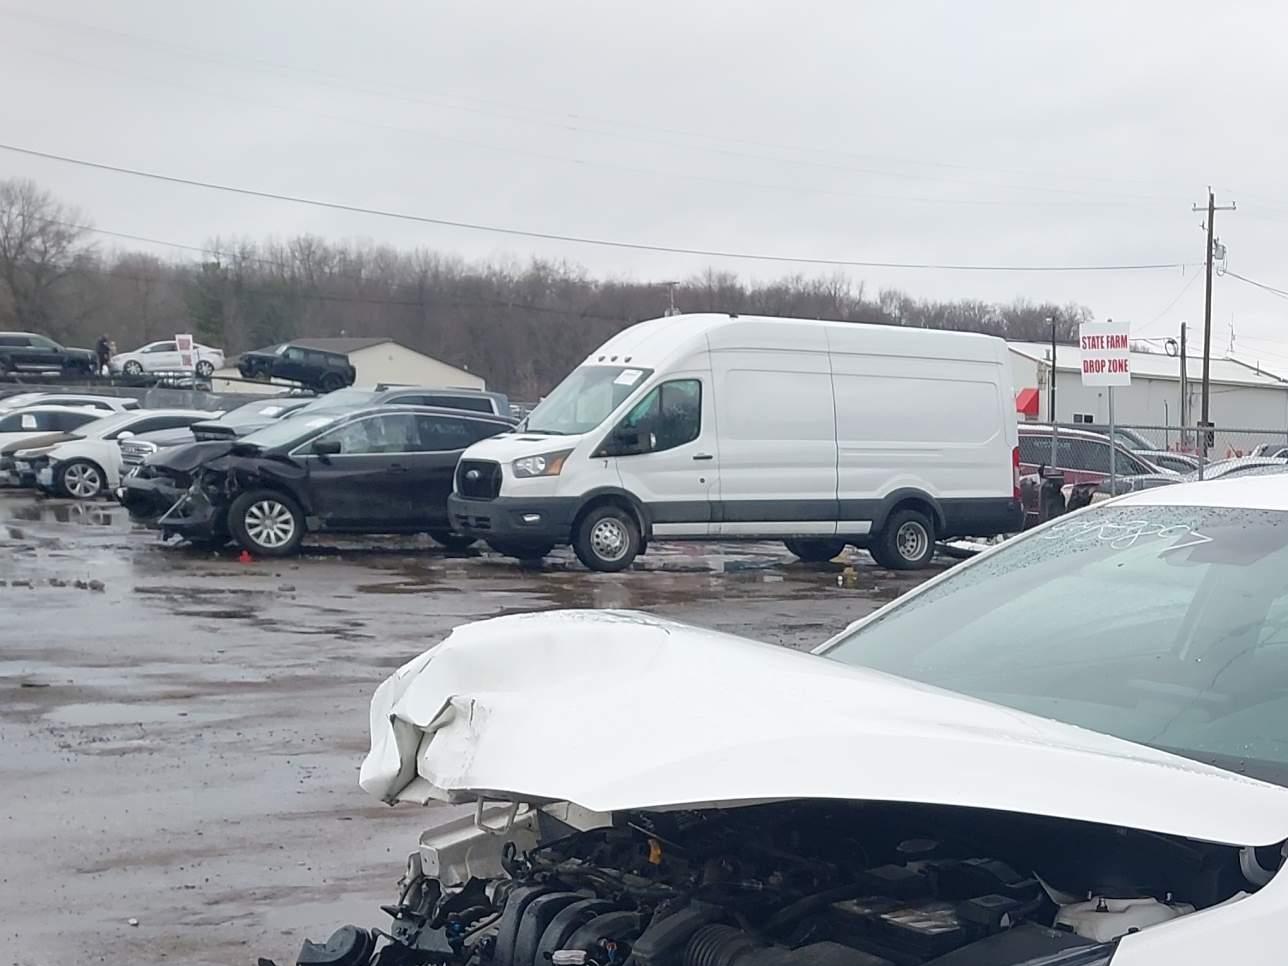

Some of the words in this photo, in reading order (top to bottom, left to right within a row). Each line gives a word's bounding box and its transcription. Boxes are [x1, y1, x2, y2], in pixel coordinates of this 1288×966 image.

[1081, 335, 1105, 350] STATE
[1106, 334, 1128, 349] FARM
[1083, 359, 1106, 374] DROP
[1107, 358, 1129, 373] ZONE
